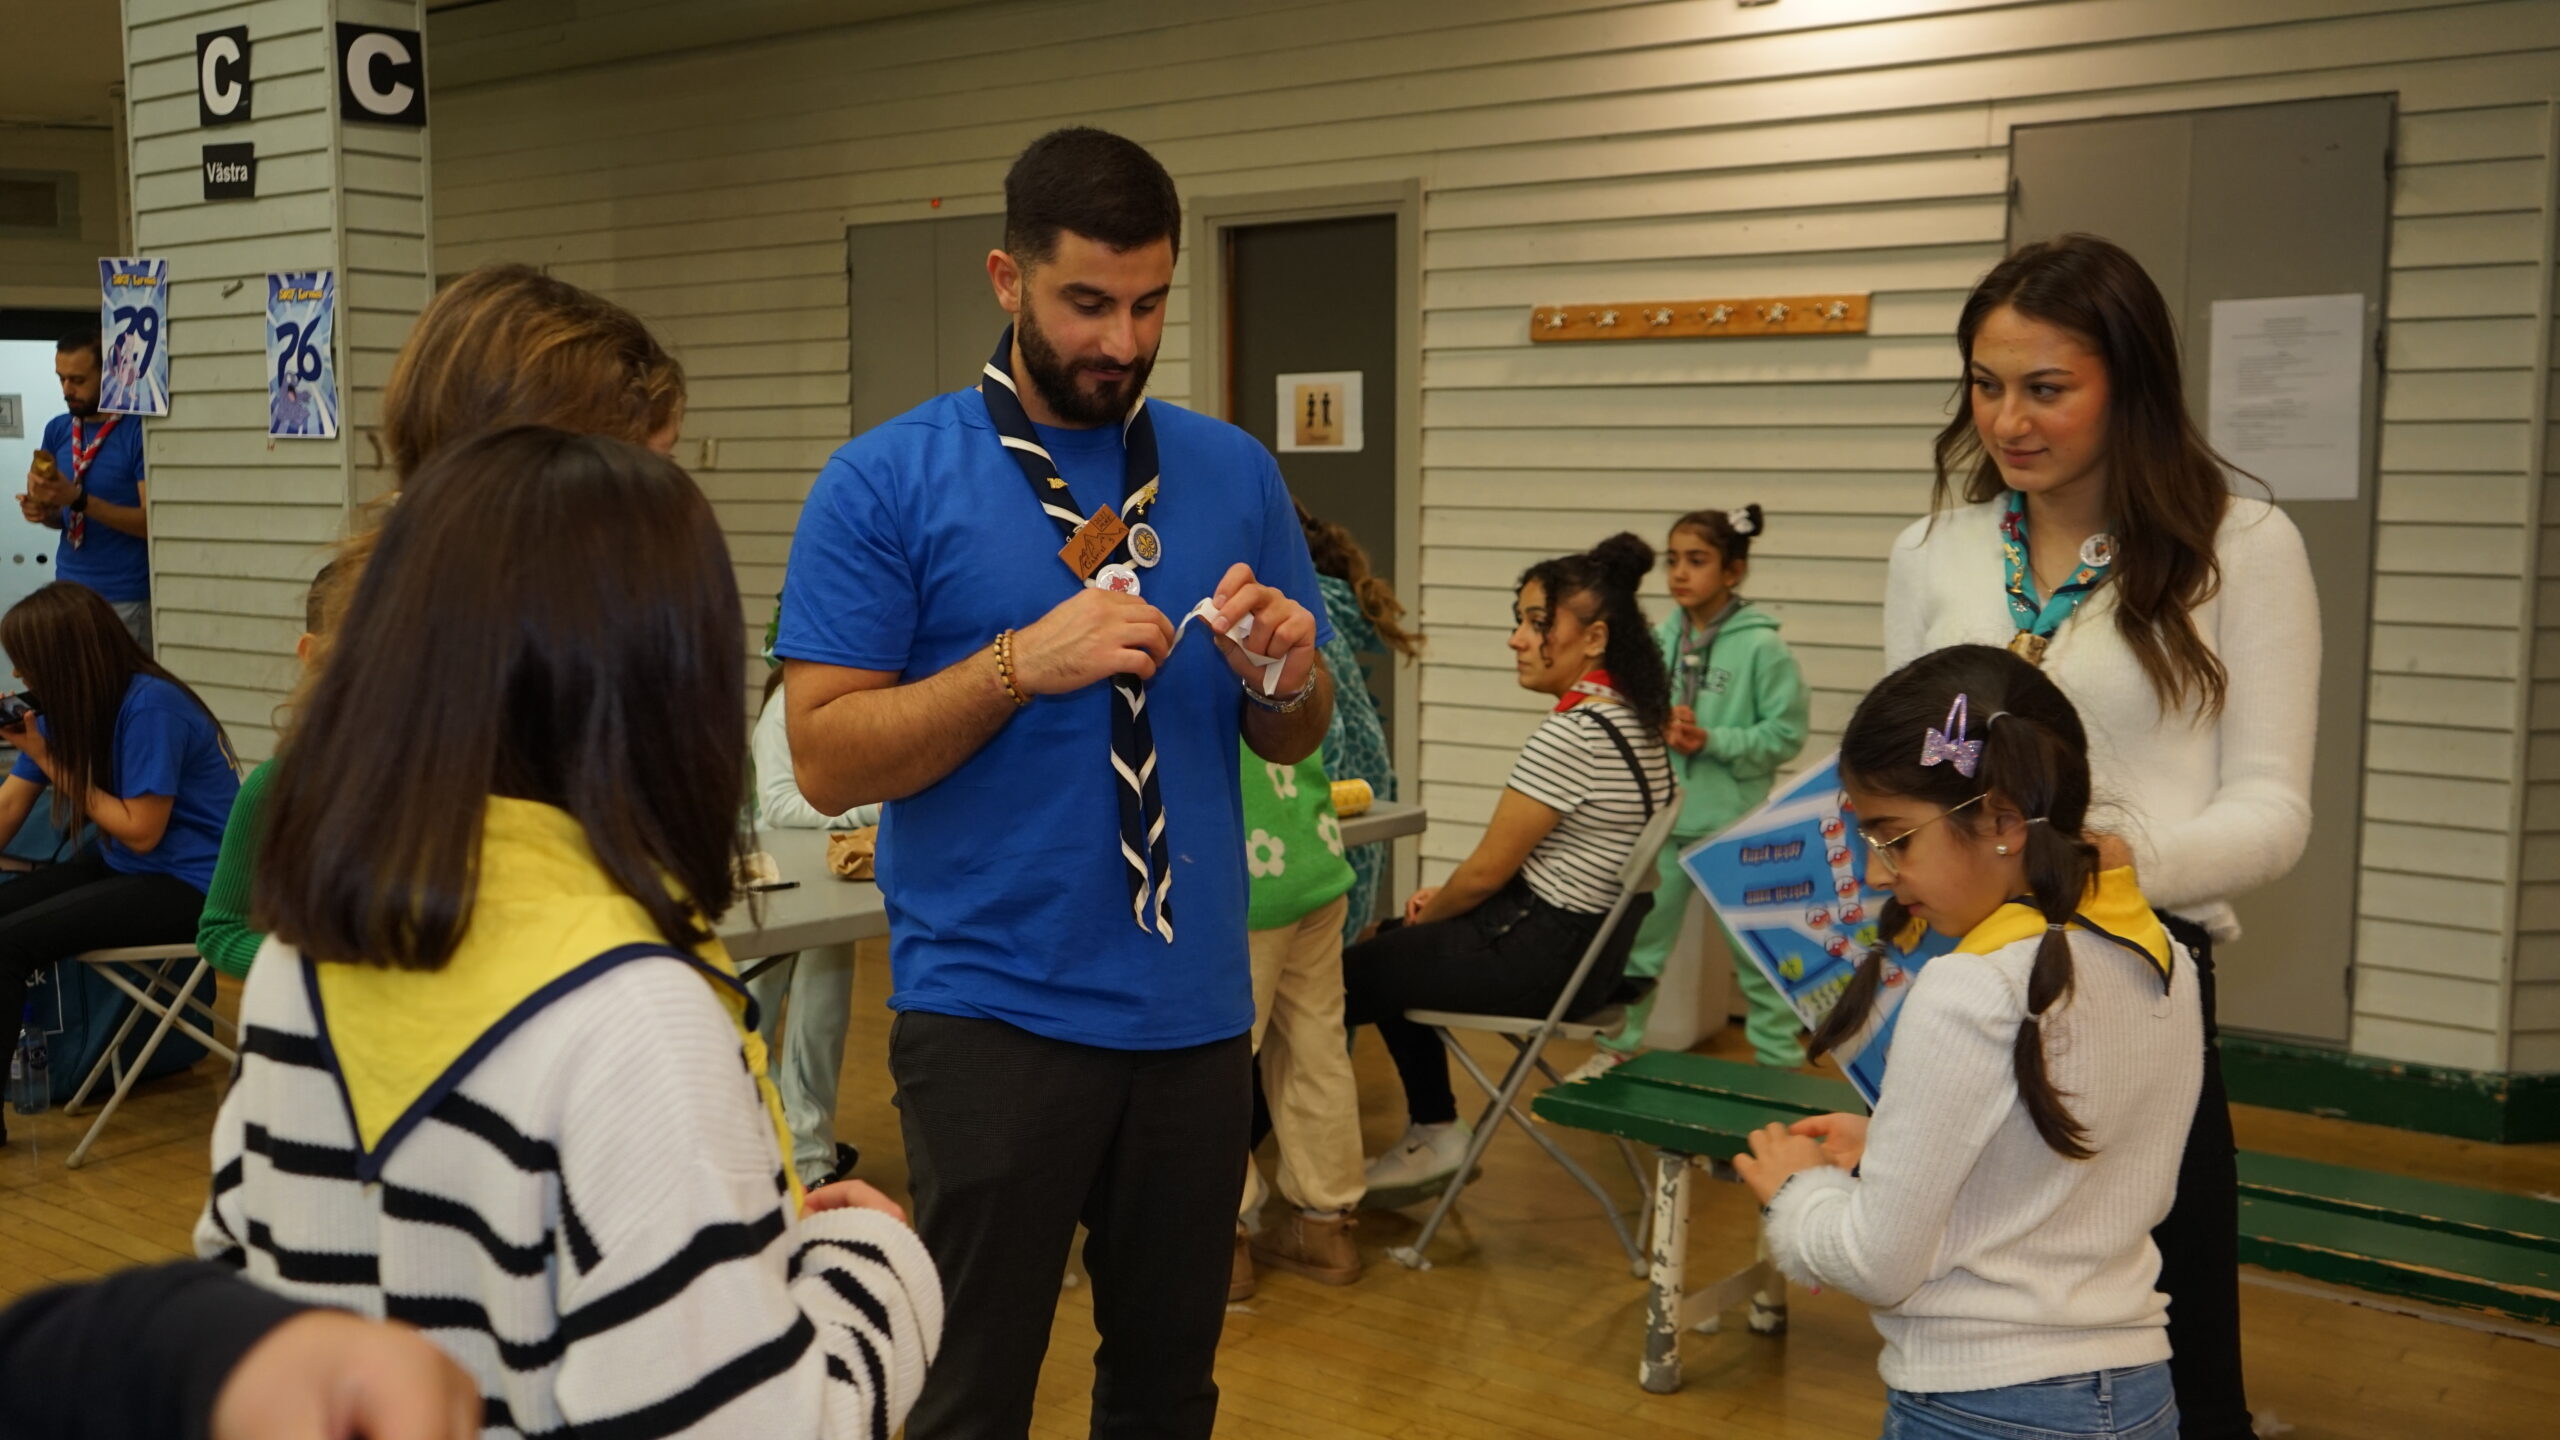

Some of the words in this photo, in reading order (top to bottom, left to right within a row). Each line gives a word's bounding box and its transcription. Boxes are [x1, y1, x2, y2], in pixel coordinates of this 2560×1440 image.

[202, 36, 242, 116] C
[346, 33, 415, 115] C
[206, 162, 248, 183] Västra
